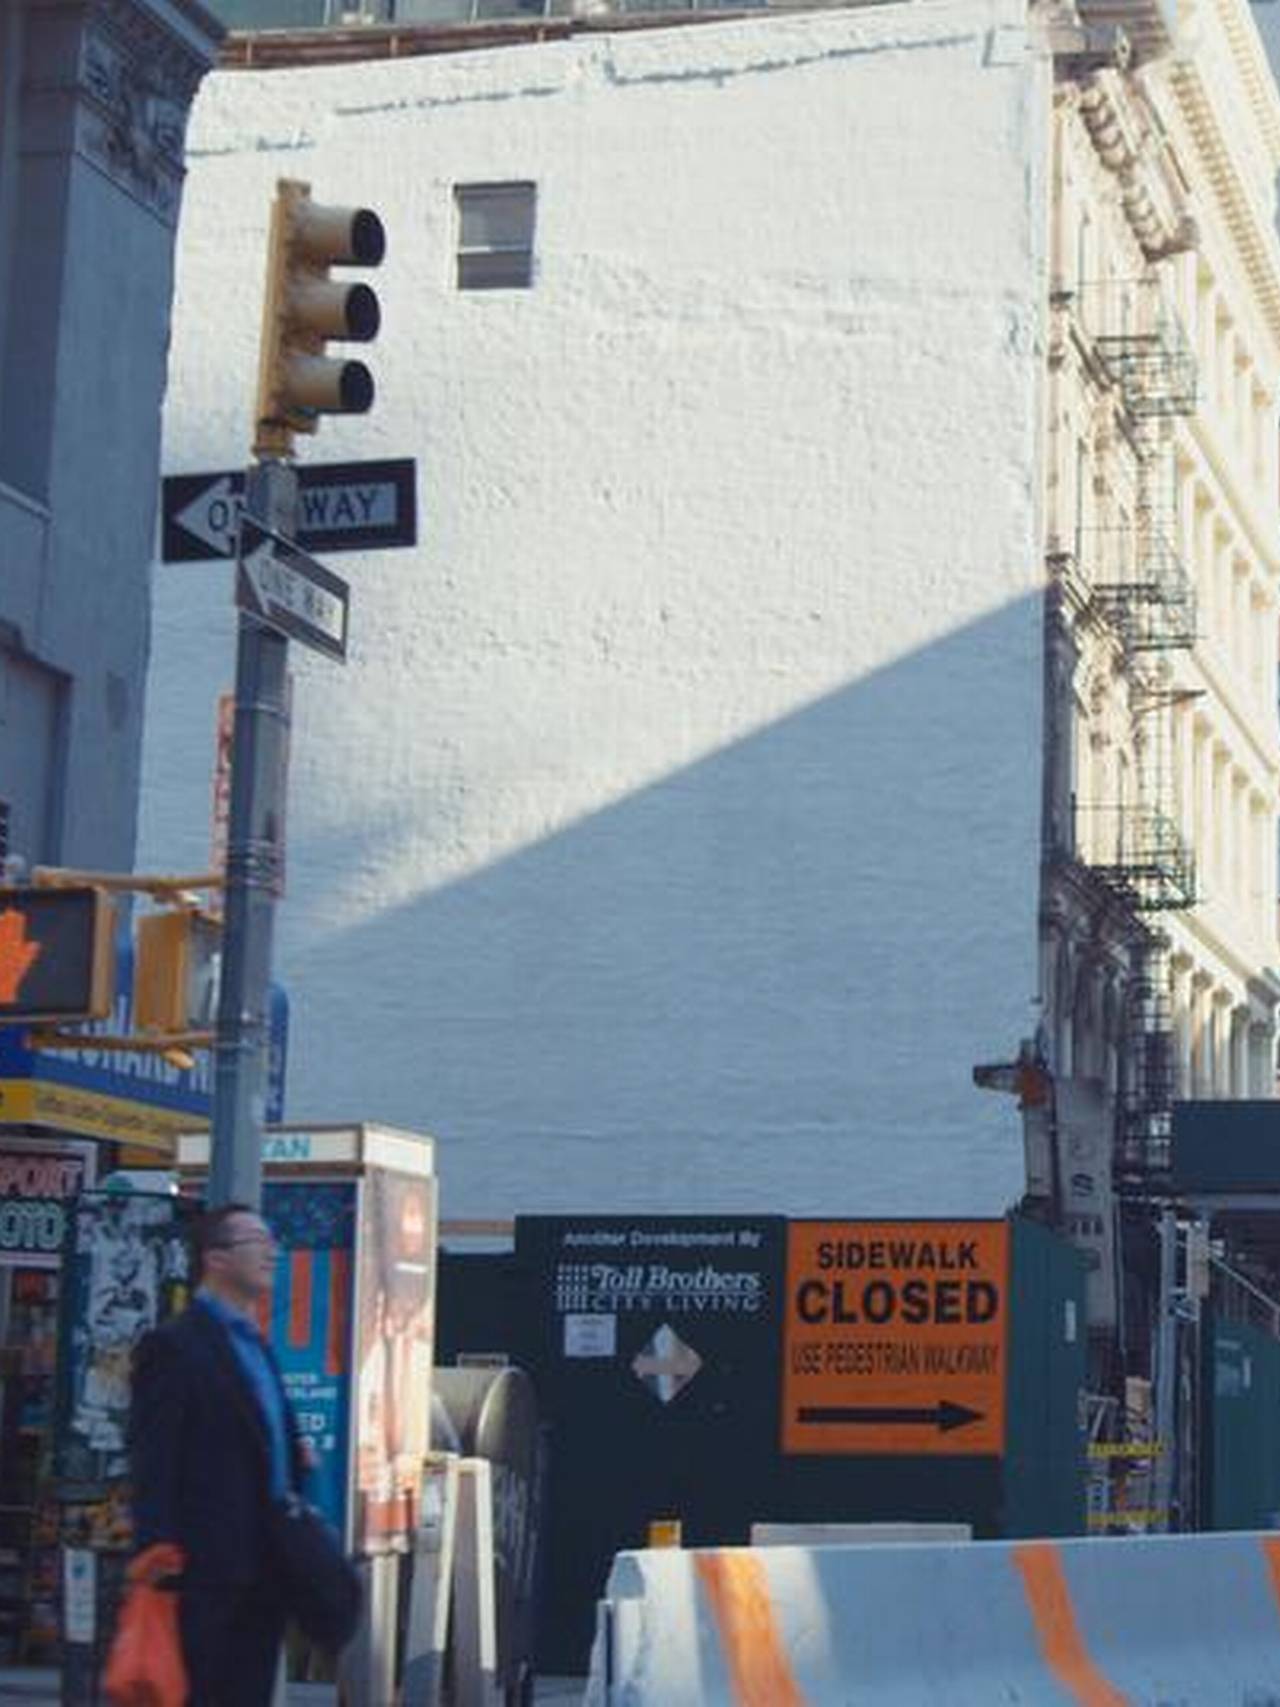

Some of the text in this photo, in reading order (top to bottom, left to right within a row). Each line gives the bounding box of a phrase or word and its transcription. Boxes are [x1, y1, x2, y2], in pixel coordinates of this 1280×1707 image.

[303, 490, 377, 524] WAY
[818, 1242, 978, 1269] SIDEWALK
[591, 1264, 761, 1290] Toll Brothers
[591, 1295, 760, 1311] CITY LIVING
[796, 1279, 998, 1324] CLOSED
[792, 1343, 821, 1375] USE
[826, 1341, 919, 1375] PEDESTRIAN
